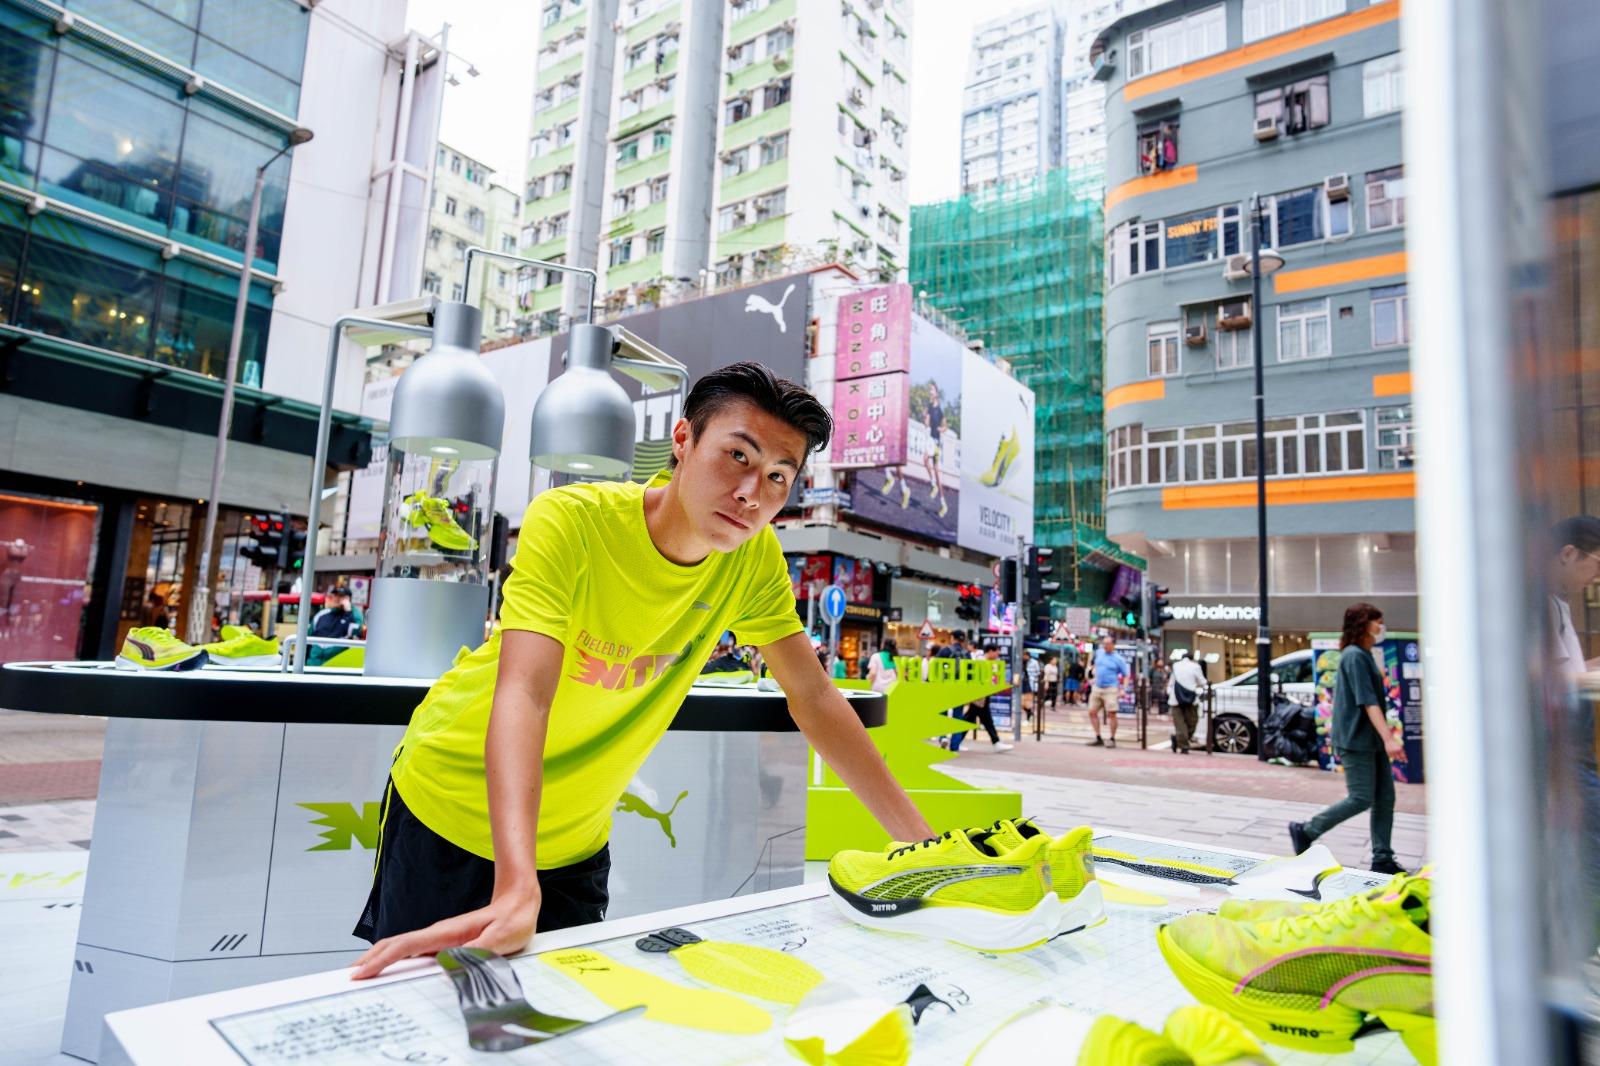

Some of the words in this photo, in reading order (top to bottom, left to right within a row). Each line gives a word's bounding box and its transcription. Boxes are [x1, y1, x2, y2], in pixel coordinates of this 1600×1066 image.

[843, 445, 886, 456] COMPUTER
[842, 453, 886, 463] CENTRE
[979, 505, 1010, 532] VELOCITY
[1163, 606, 1196, 620] new
[576, 629, 615, 657] FUELED
[617, 643, 633, 658] BY
[871, 903, 898, 912] NITRO
[1268, 1022, 1320, 1039] NITRO
